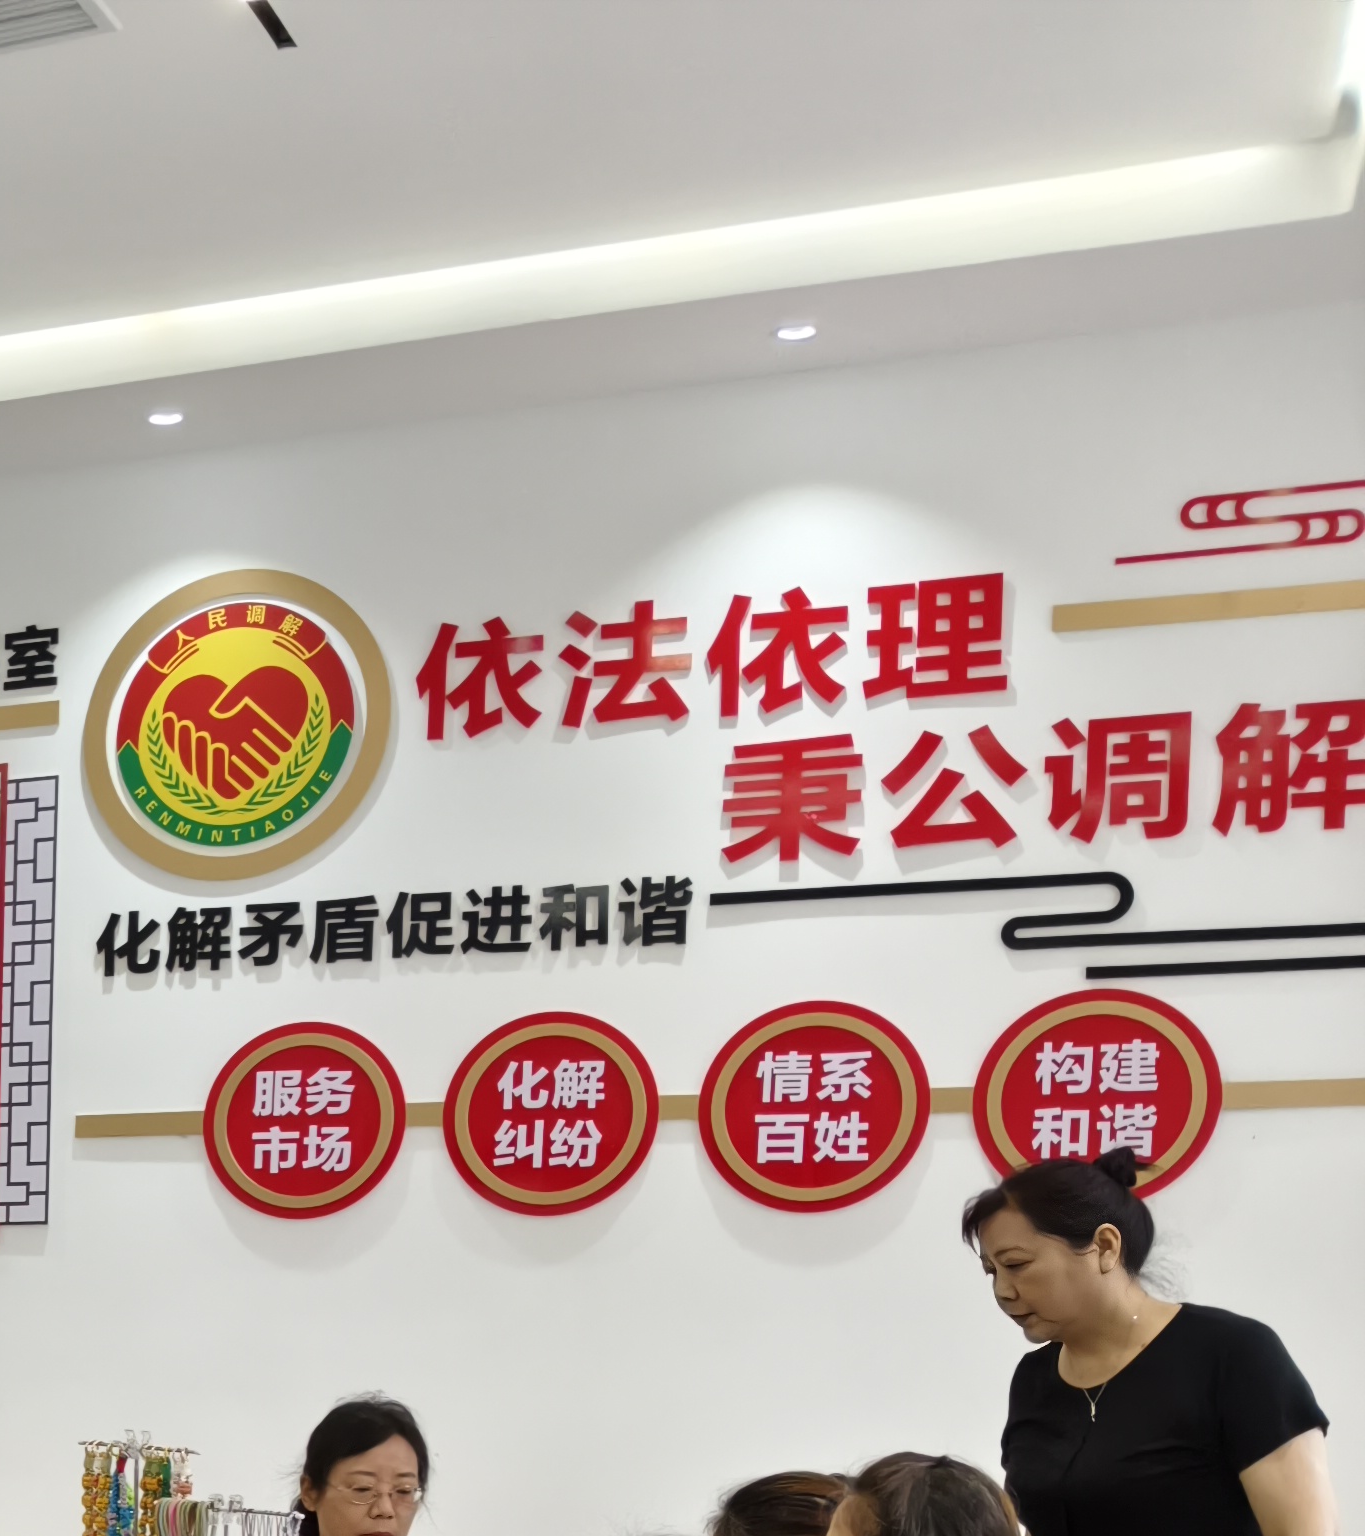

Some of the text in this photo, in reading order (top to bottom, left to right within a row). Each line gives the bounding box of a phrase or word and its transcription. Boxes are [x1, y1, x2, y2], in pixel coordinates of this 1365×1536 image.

[175, 605, 303, 650] 人民调解
[415, 573, 1008, 740] 依法依理
[134, 768, 333, 842] RENMINTIAOJIE
[720, 699, 1365, 864] 秉公调解
[96, 875, 693, 977] 化解矛盾促进和谐
[252, 1067, 355, 1117] 服务
[497, 1059, 605, 1110] 化解
[756, 1051, 872, 1103] 情系
[1035, 1039, 1160, 1095] 构建
[252, 1125, 352, 1173] 市场
[493, 1119, 602, 1168] 纠纷
[755, 1111, 869, 1163] 百姓
[1031, 1103, 1158, 1159] 和谐
